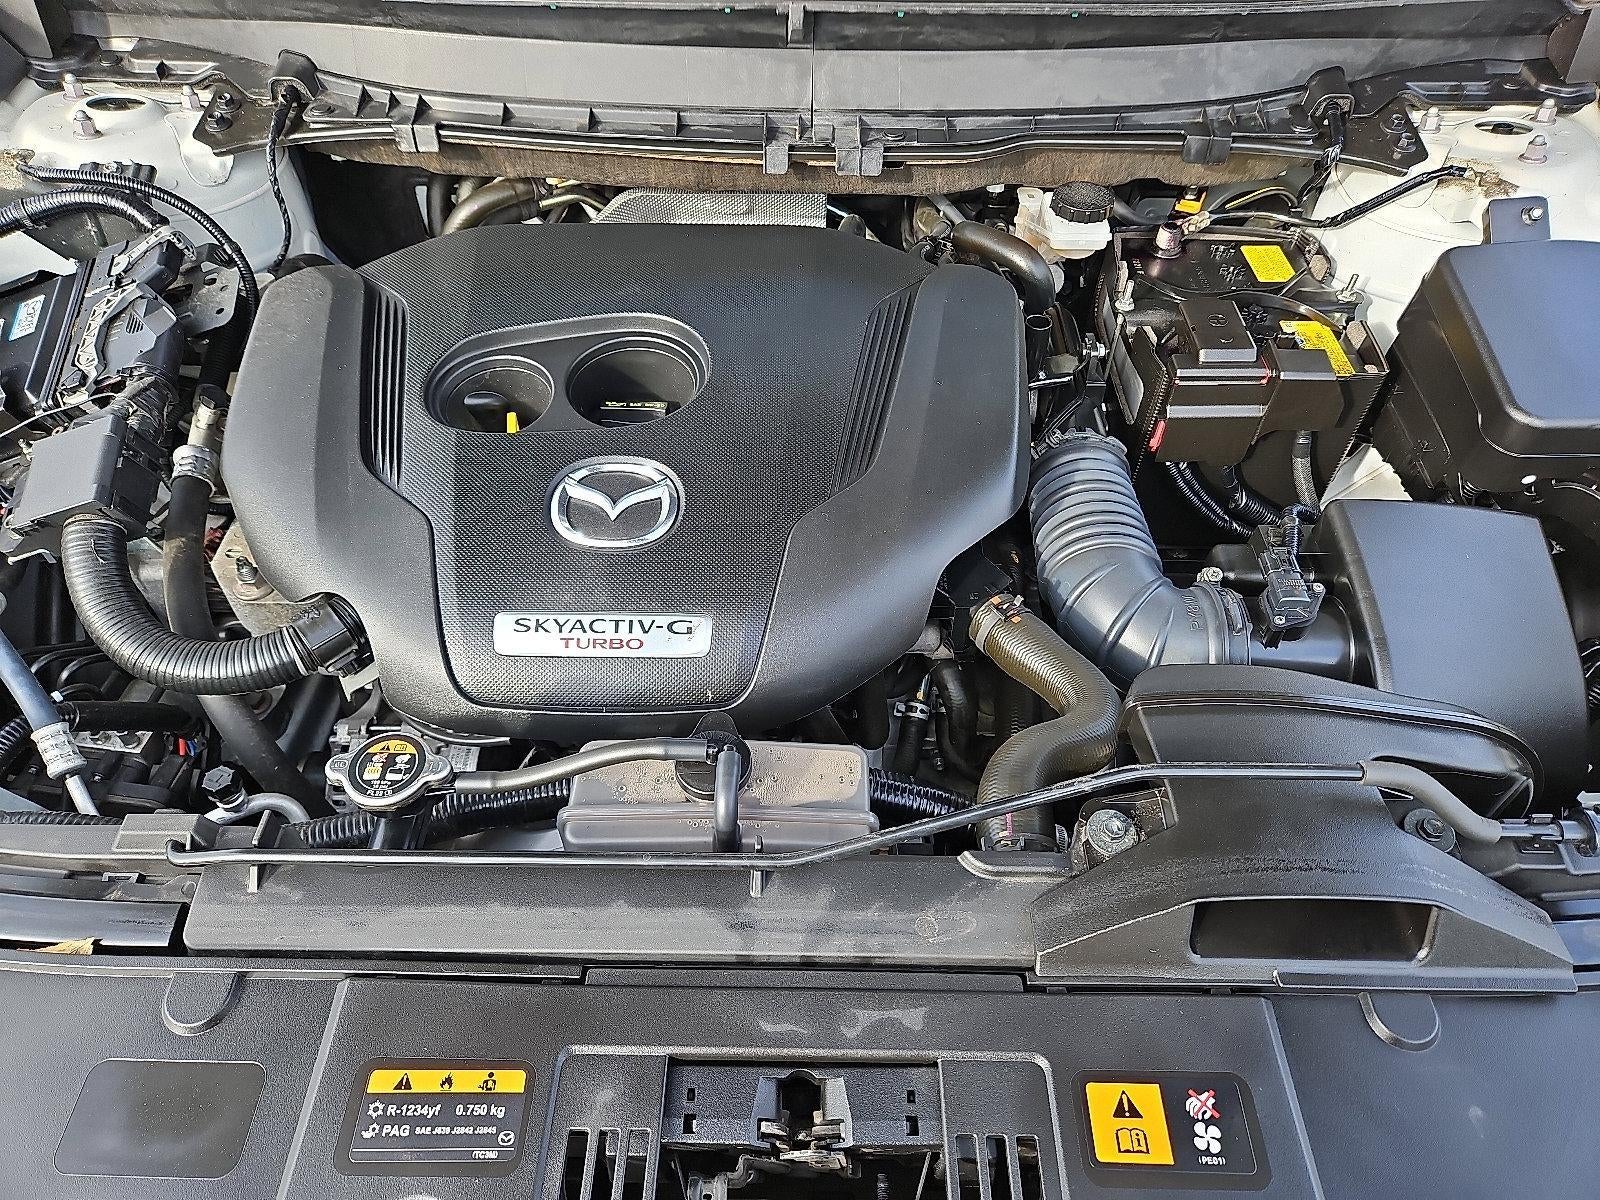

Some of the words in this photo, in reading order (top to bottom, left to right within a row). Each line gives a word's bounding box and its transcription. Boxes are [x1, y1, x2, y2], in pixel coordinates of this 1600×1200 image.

[513, 617, 693, 635] SKYACTIV-G
[559, 637, 644, 650] TURBO
[386, 1104, 441, 1118] R-1234yf
[455, 1104, 487, 1116] 0.750
[490, 1104, 506, 1118] kg
[382, 1124, 410, 1137] PAG
[414, 1126, 432, 1134] SAE
